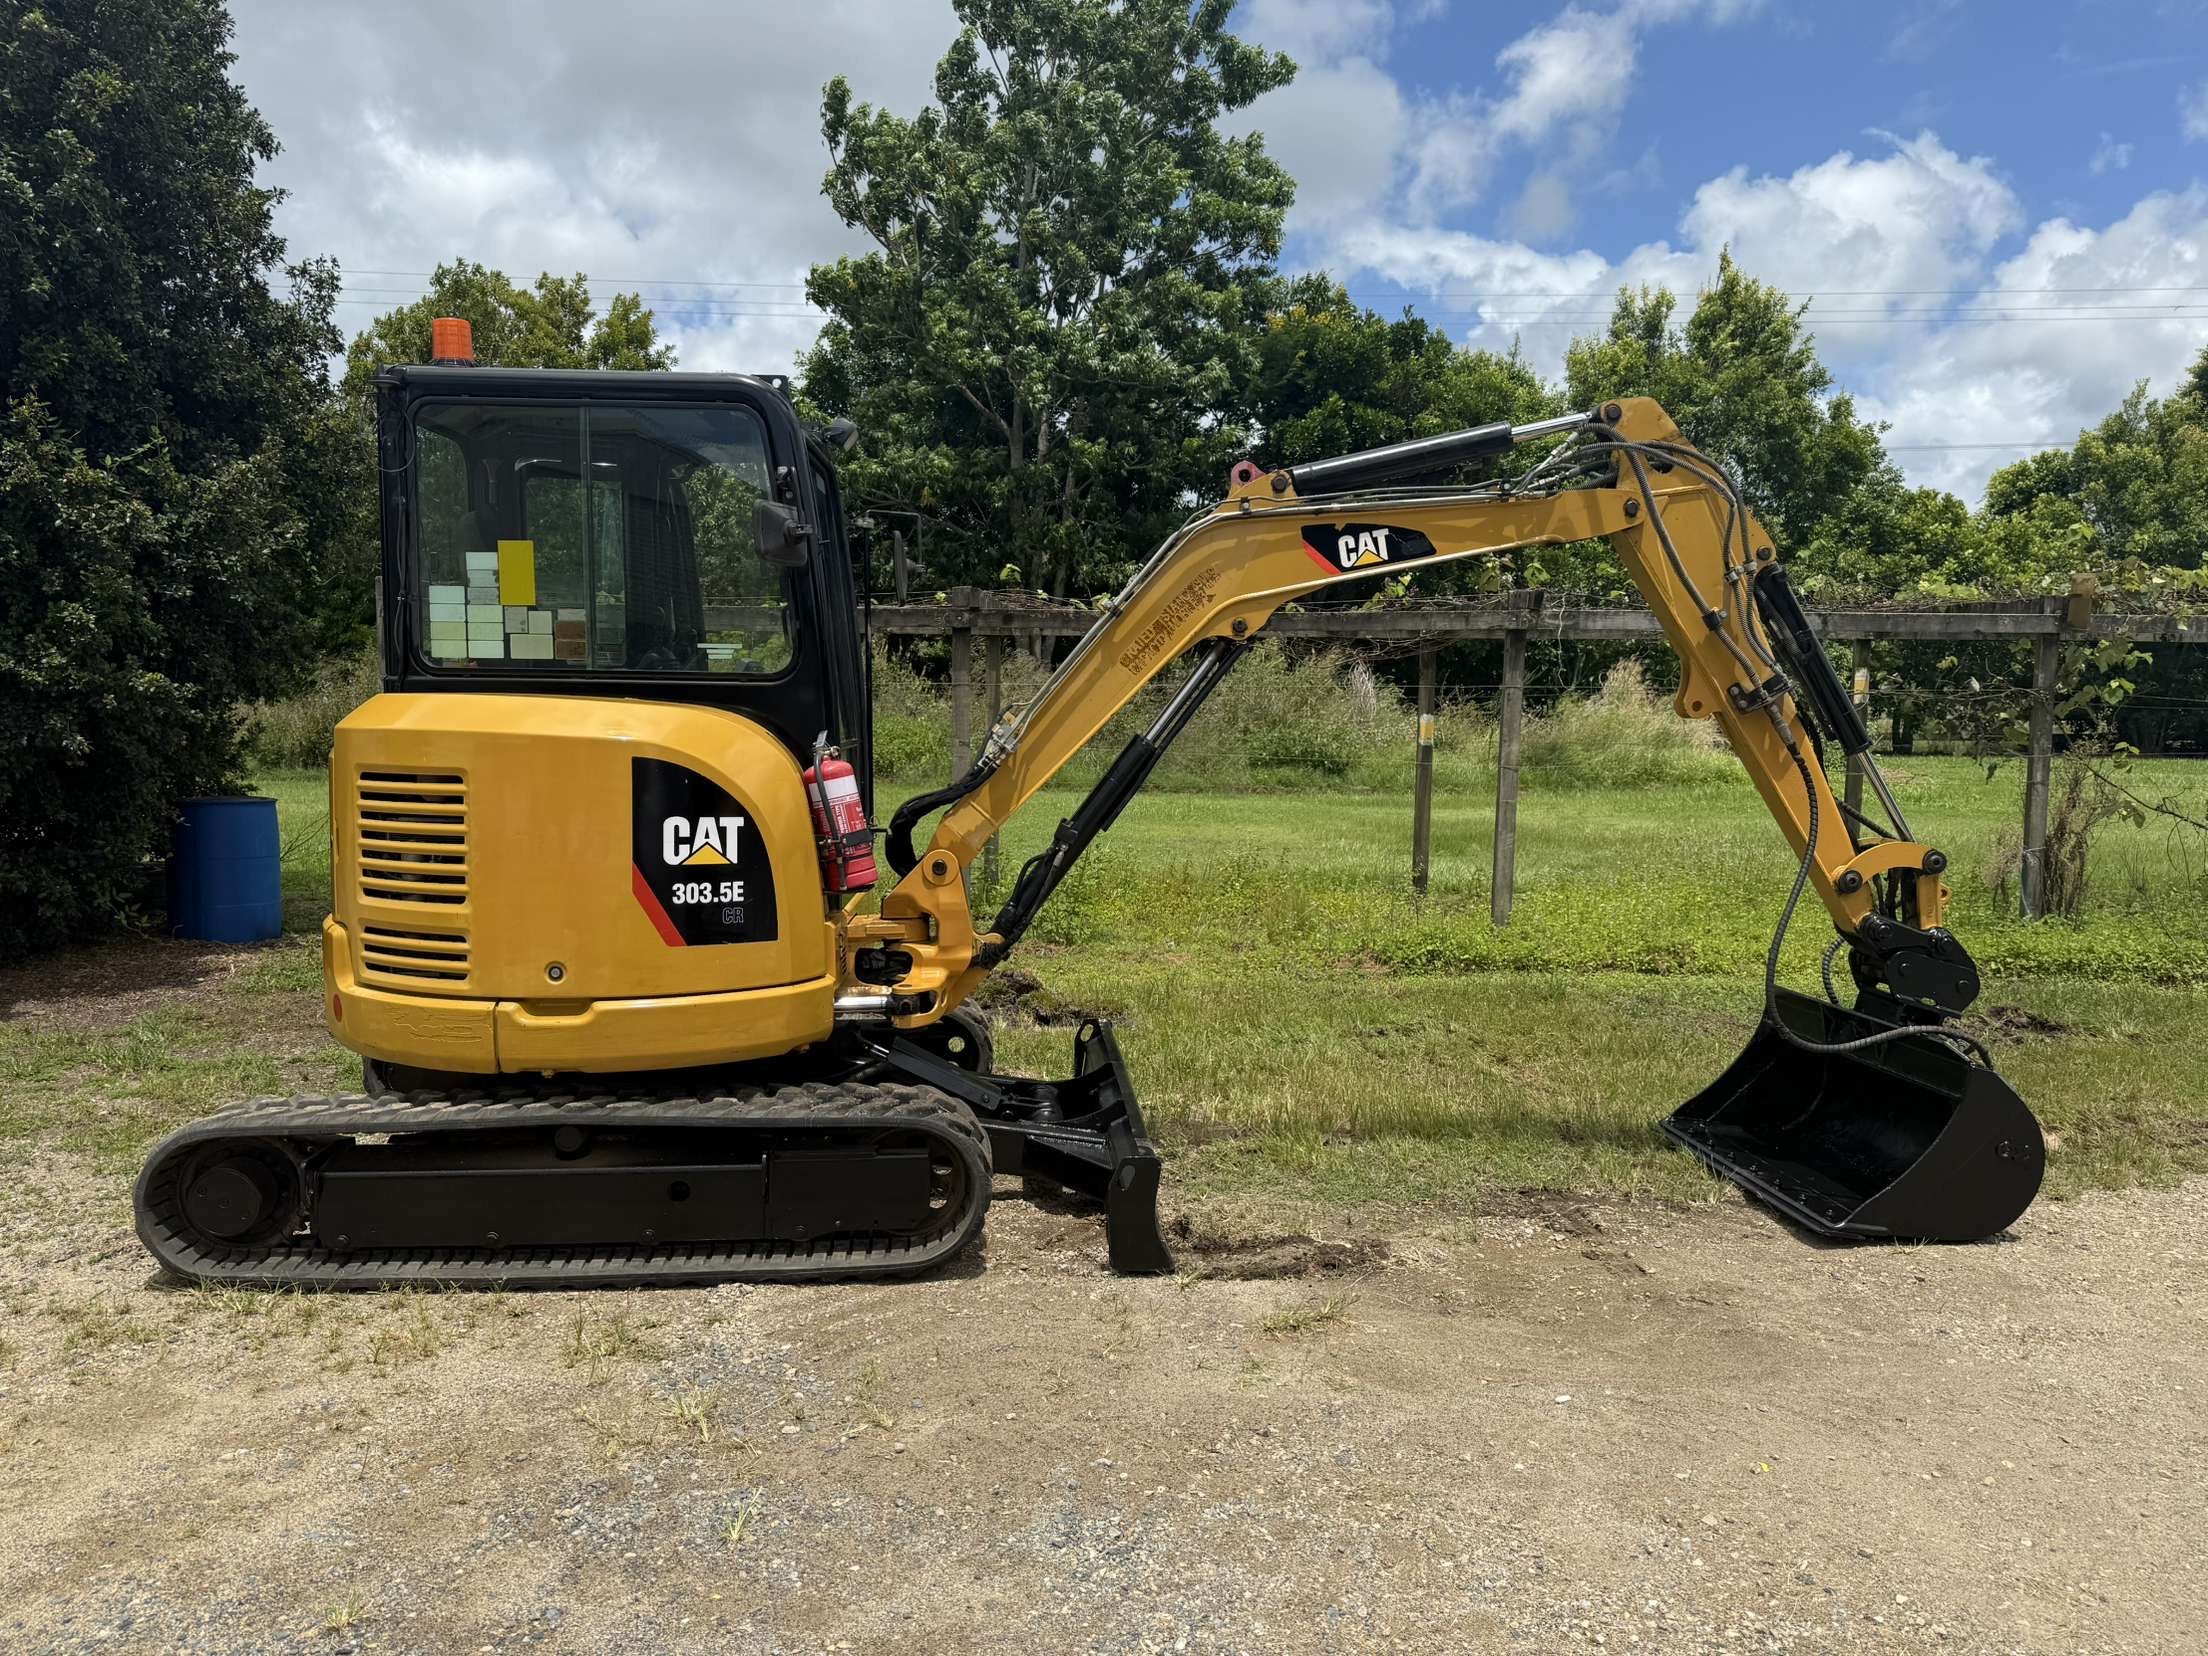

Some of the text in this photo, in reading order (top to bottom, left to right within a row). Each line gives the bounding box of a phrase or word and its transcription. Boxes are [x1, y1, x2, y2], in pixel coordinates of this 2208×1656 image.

[1338, 528, 1389, 568] CAT
[663, 816, 744, 865] CAT
[672, 881, 744, 904] 303.5E
[722, 907, 744, 924] CR
